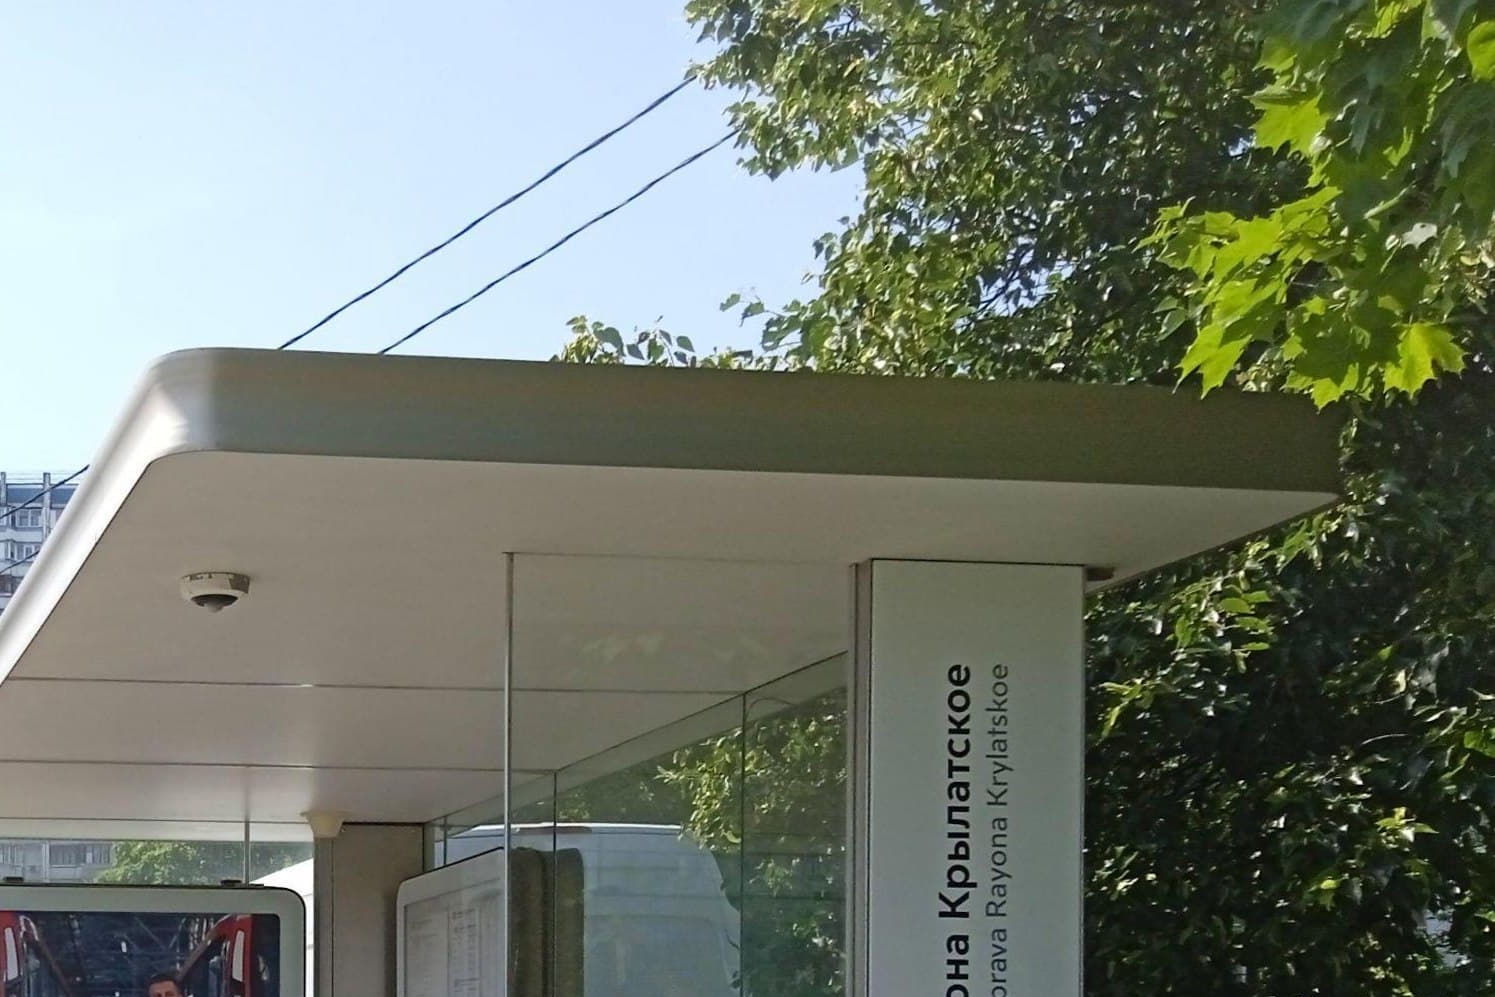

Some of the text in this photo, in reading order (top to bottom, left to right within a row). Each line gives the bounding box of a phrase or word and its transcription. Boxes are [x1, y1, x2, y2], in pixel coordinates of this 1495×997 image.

[938, 664, 978, 918] Крылатское
[985, 663, 1014, 806] Krylatskoe
[985, 817, 1012, 917] Rayona
